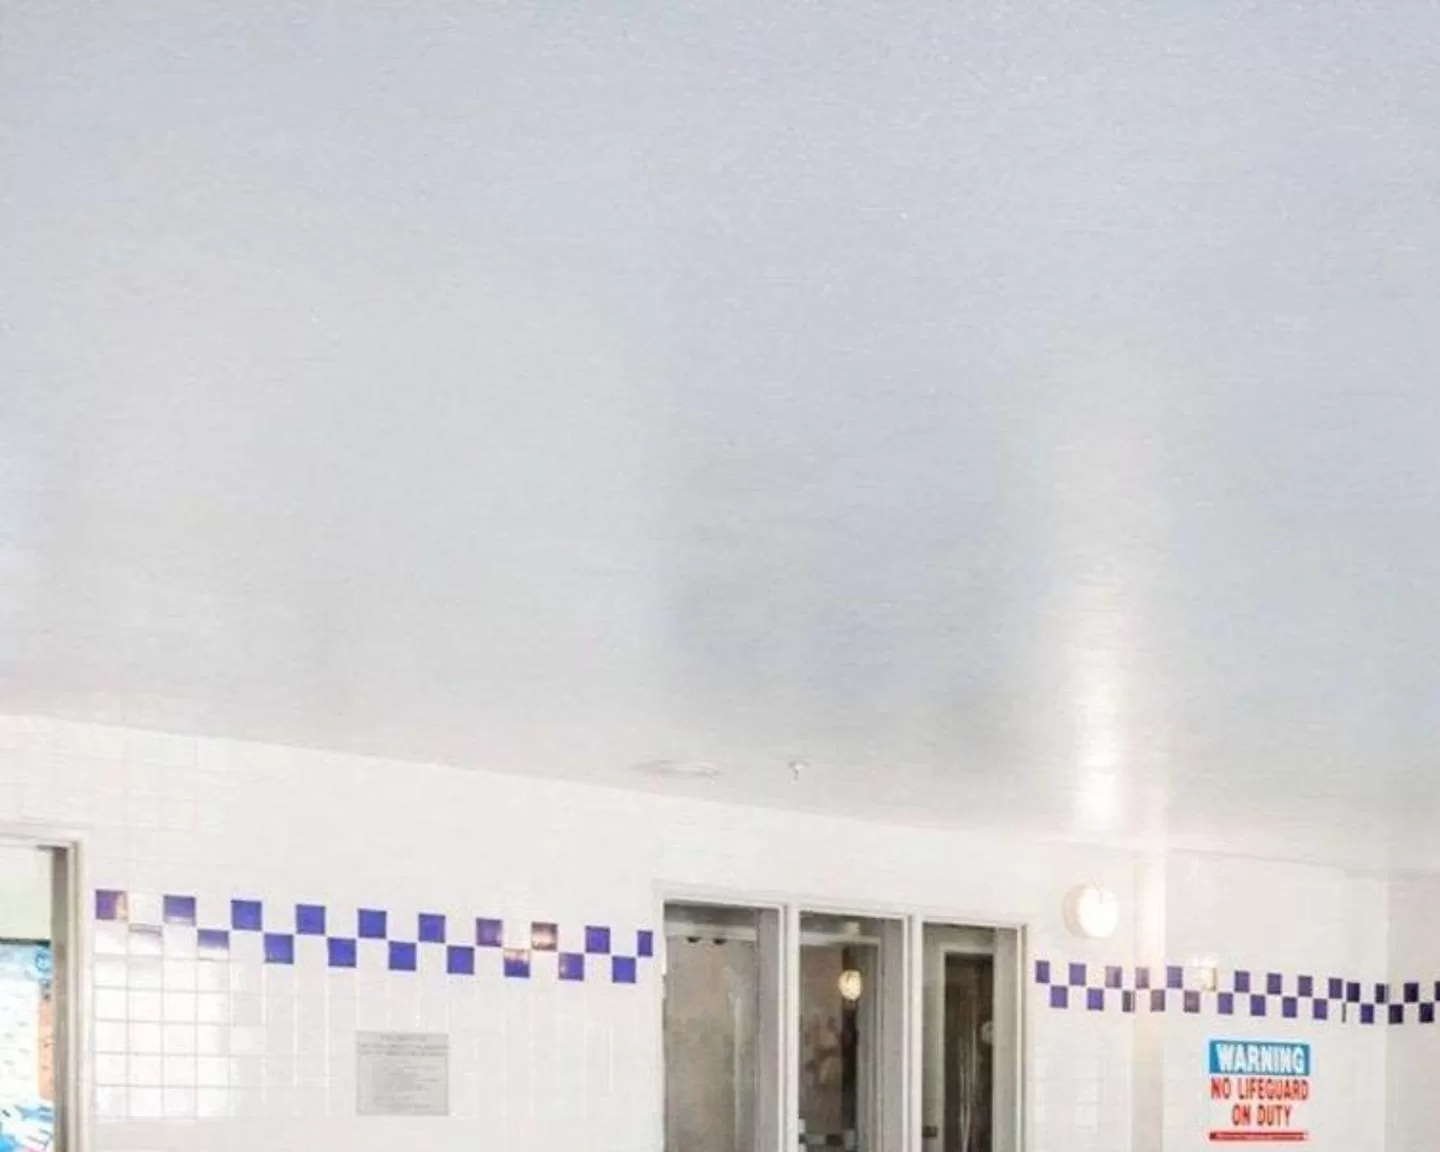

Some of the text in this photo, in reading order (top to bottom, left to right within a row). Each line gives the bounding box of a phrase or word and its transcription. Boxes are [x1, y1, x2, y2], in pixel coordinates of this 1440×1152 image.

[1215, 1042, 1306, 1074] WARNING
[1211, 1077, 1309, 1100] NO LIFEGUARD
[1232, 1103, 1291, 1126] ON DUTY
